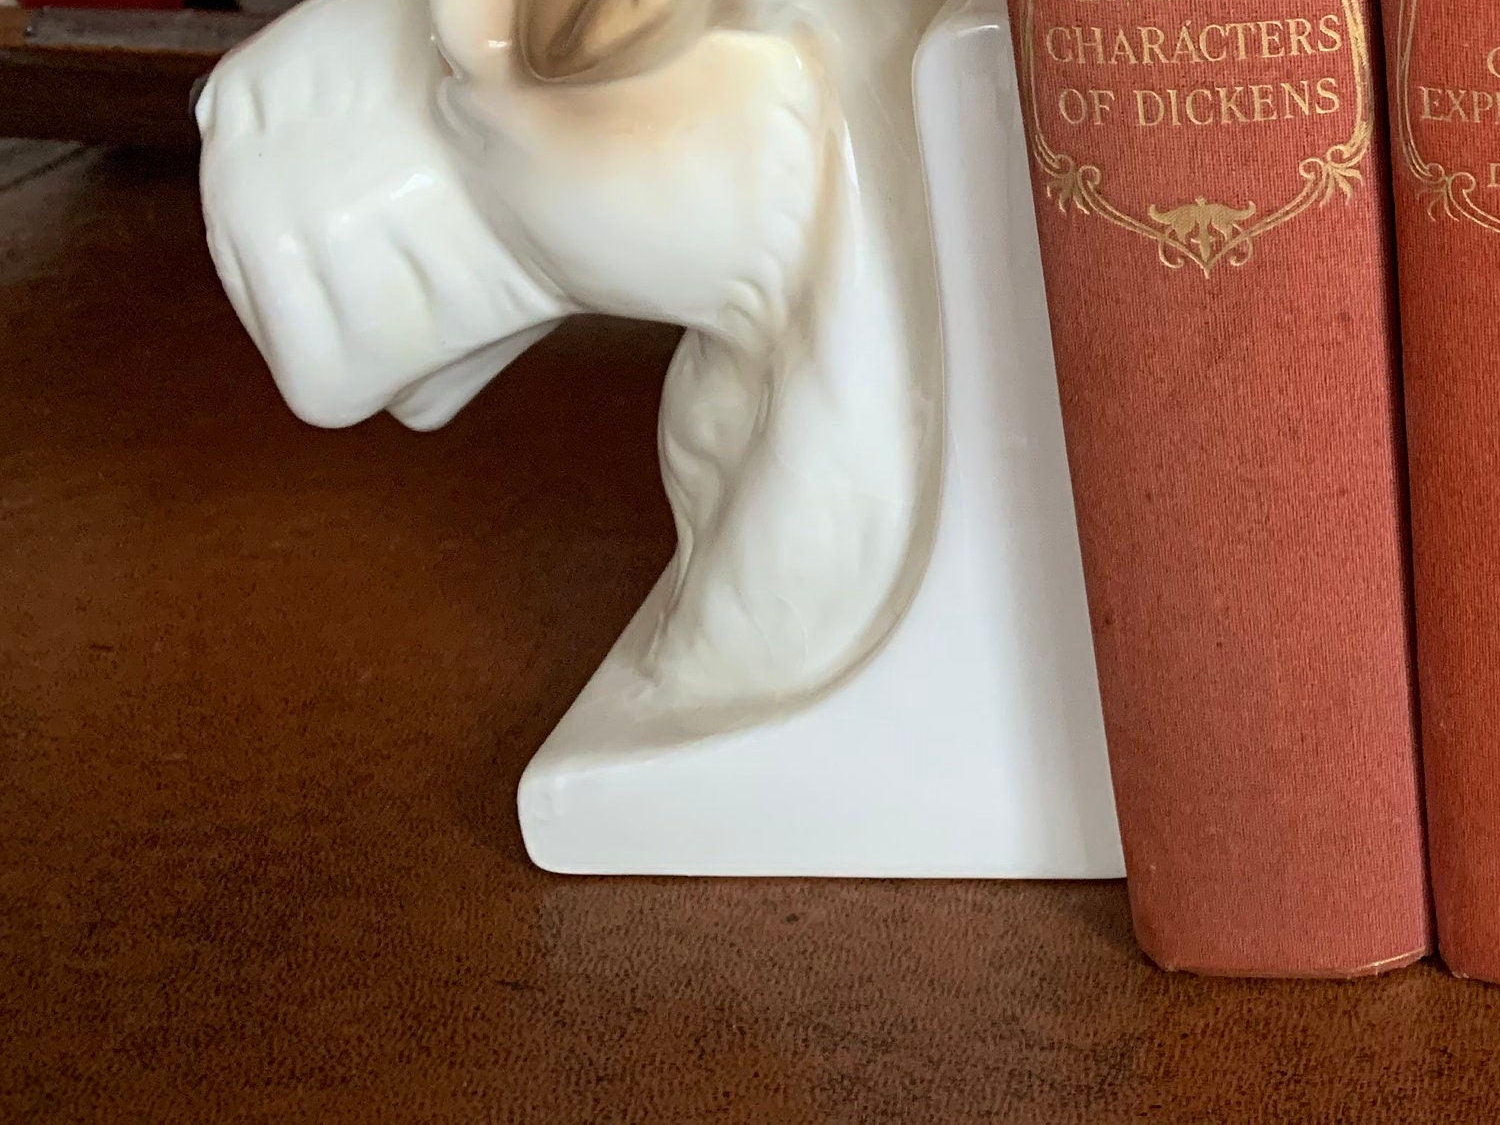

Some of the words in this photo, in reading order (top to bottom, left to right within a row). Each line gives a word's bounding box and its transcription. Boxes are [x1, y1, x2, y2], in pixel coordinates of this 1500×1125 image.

[1045, 14, 1343, 65] CHARACTERS
[1058, 87, 1115, 125] OF
[1136, 77, 1341, 127] DICKENS
